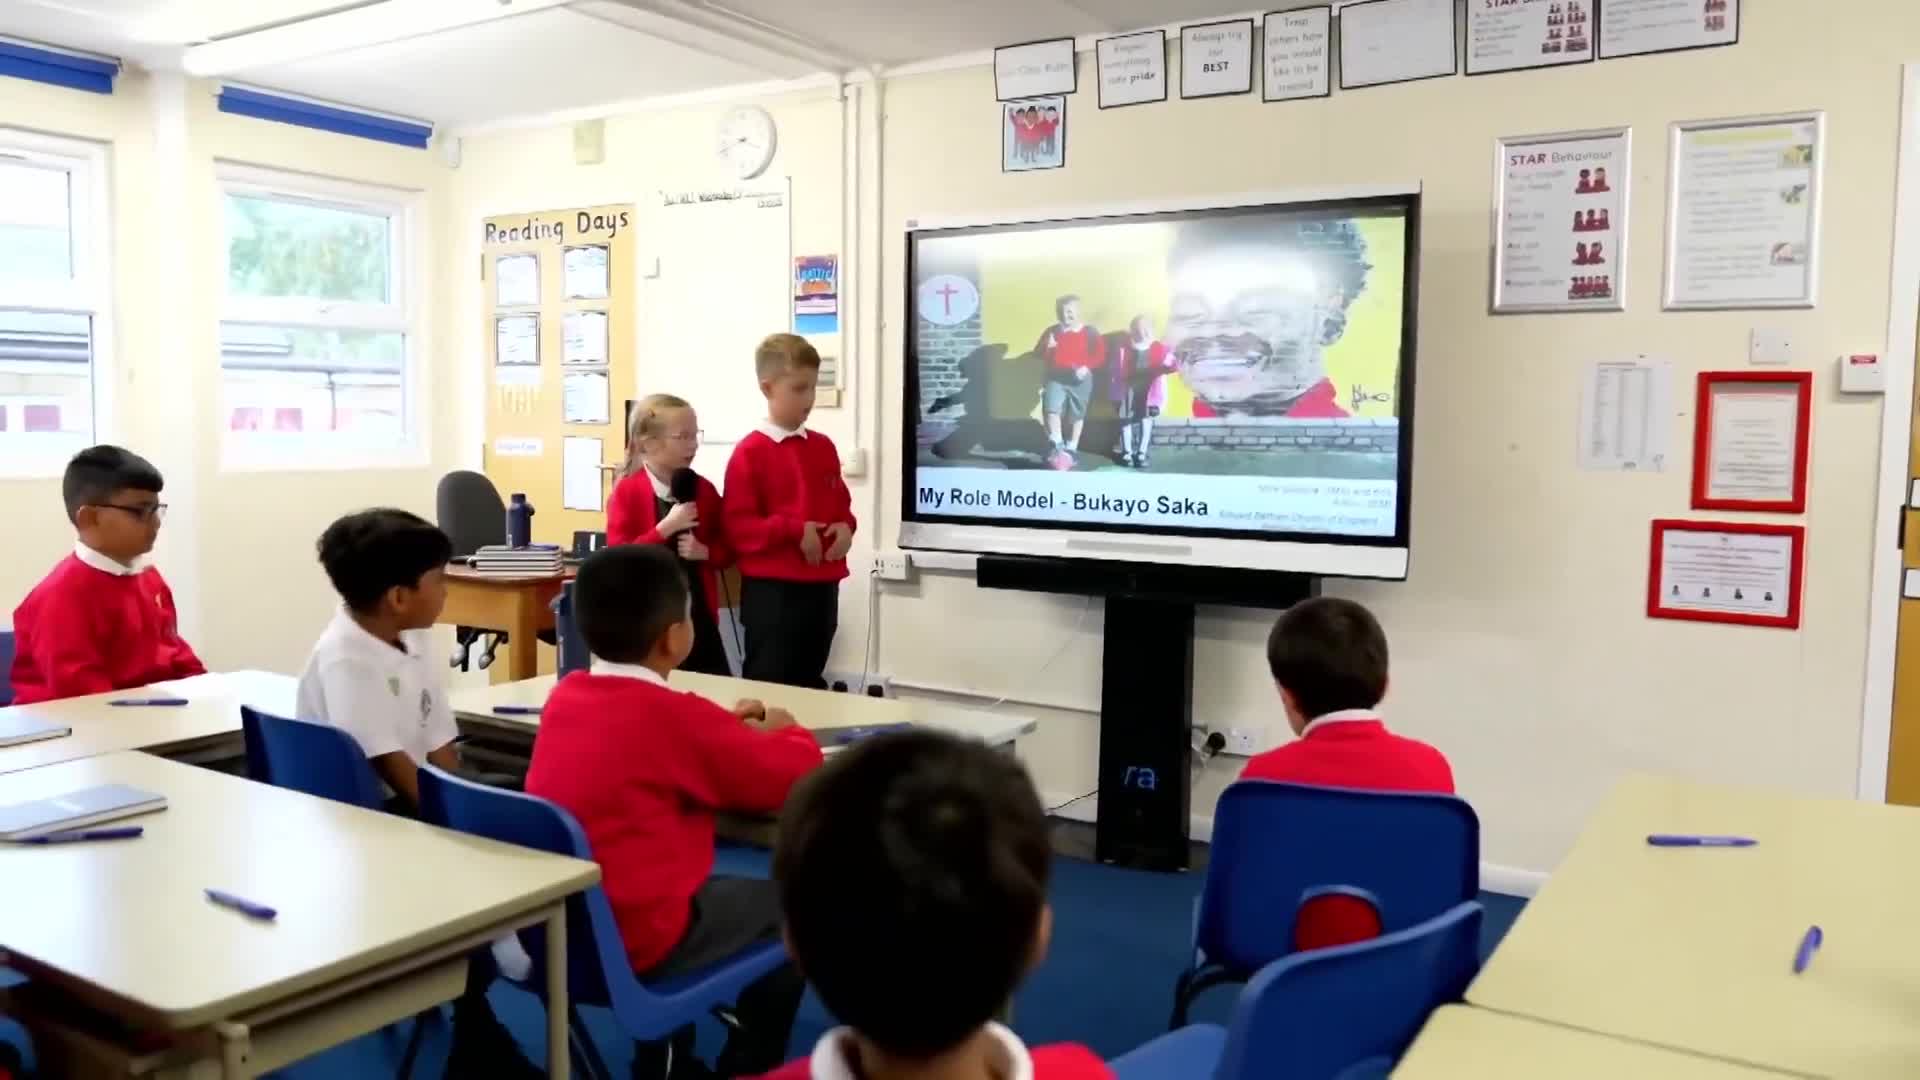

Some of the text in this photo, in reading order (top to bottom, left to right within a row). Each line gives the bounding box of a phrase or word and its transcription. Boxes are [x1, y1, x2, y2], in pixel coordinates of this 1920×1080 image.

[1202, 61, 1230, 73] BEST
[1130, 72, 1156, 85] pride
[1510, 150, 1613, 166] STAR Behaviour
[485, 211, 630, 246] Reading Days
[919, 487, 944, 508] My
[950, 488, 991, 506] Role
[997, 489, 1054, 509] Model
[1074, 493, 1150, 517] Bukayo
[1157, 496, 1209, 516] Saka
